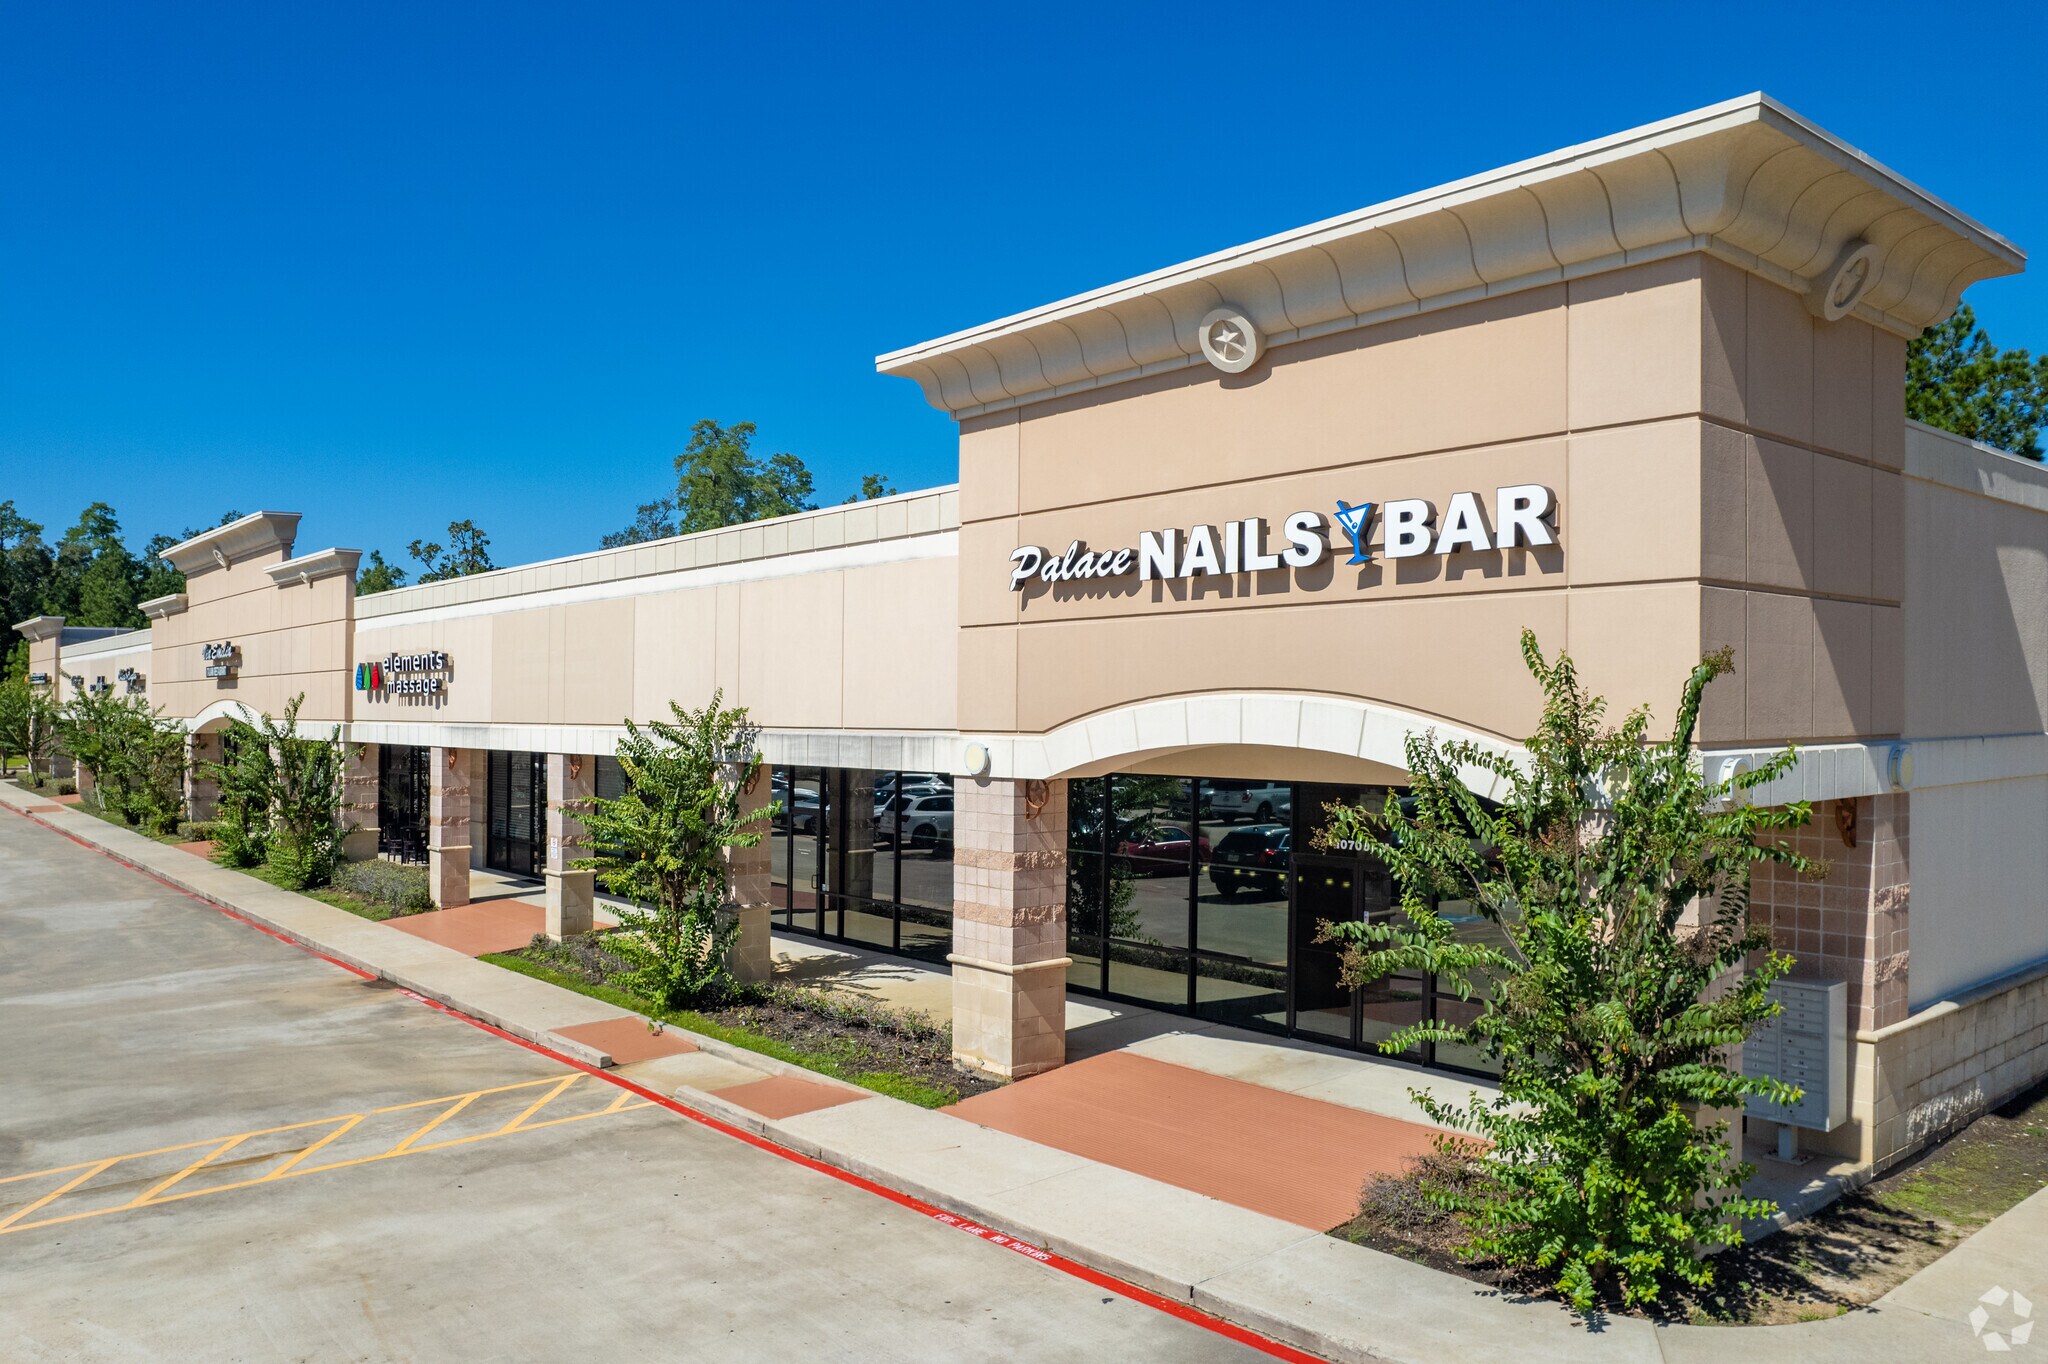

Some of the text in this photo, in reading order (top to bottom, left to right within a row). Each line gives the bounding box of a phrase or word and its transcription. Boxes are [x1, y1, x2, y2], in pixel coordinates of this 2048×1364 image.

[1009, 484, 1556, 593] Palace NAILS BAR
[383, 652, 444, 673] elements
[387, 678, 438, 696] massage
[934, 1213, 959, 1225] FIRE
[958, 1223, 988, 1236] LANE
[989, 1234, 1009, 1244] NO
